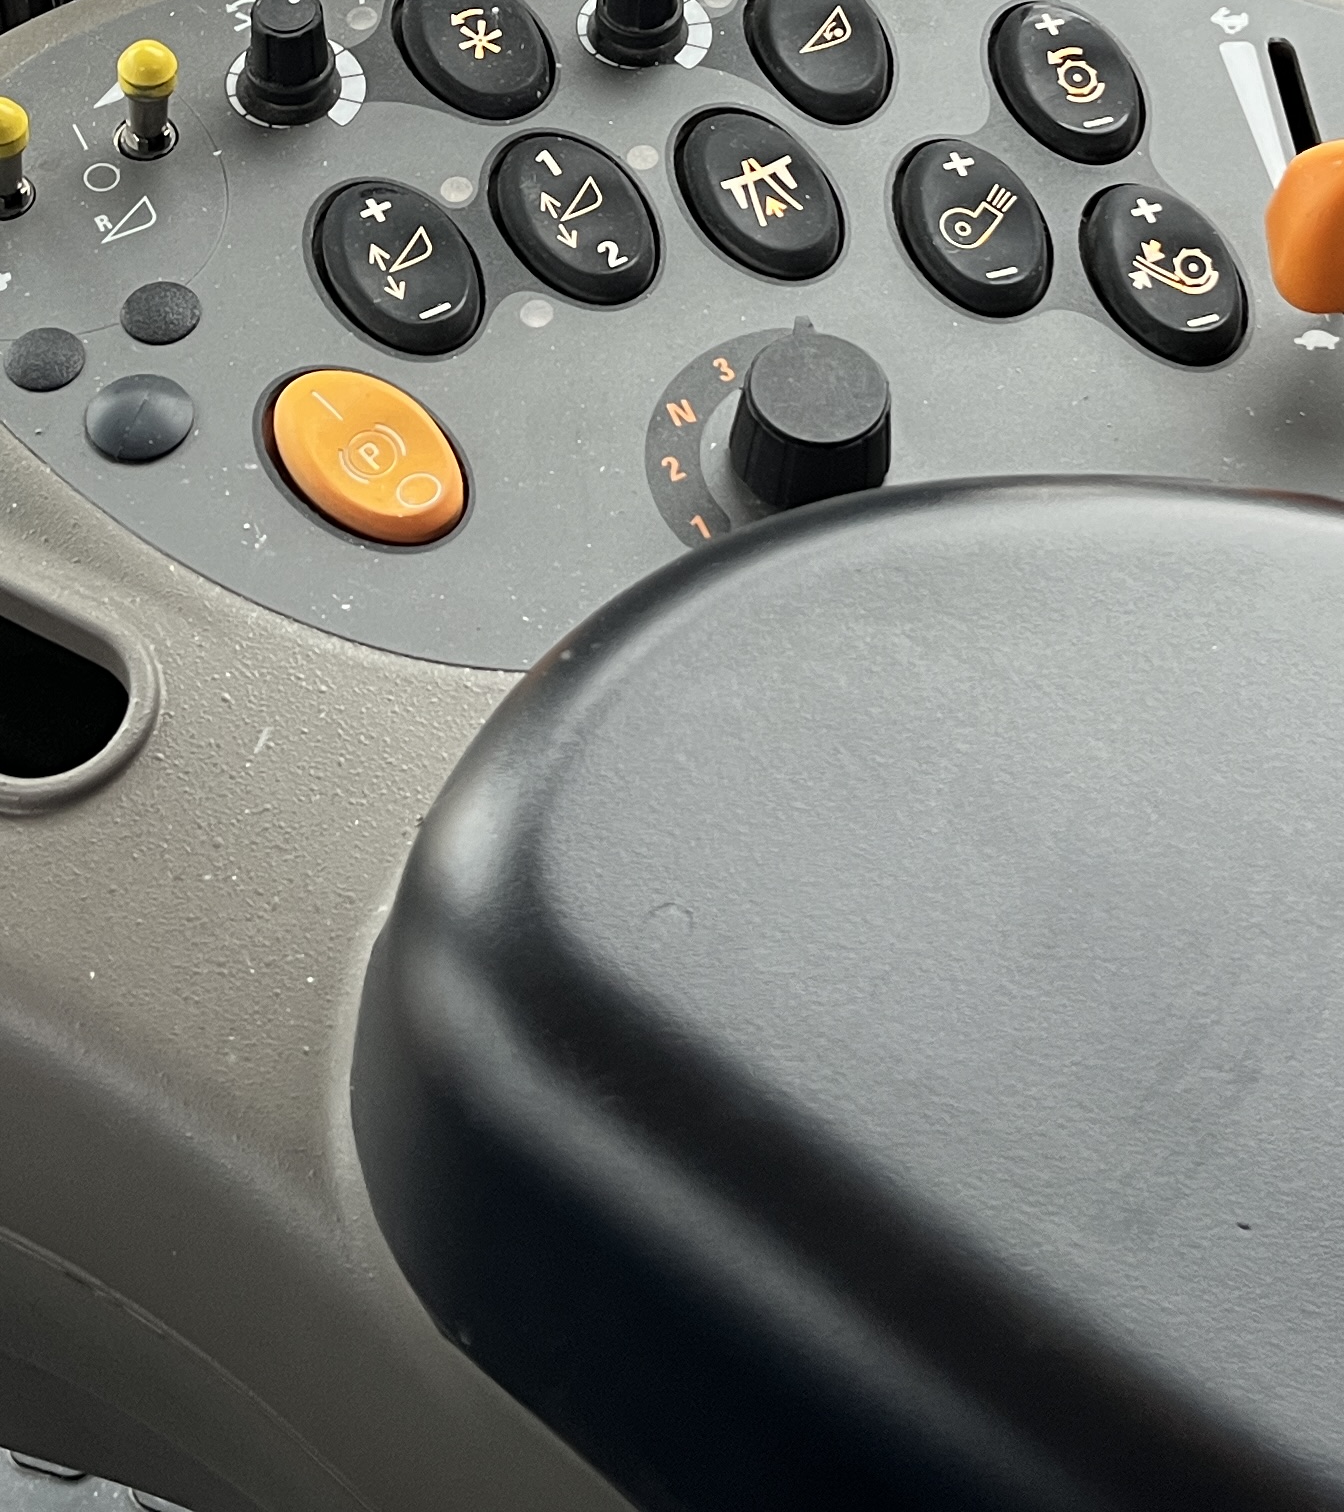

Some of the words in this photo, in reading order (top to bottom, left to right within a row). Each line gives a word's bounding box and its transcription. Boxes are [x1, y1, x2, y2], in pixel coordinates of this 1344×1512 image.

[535, 149, 563, 176] 1
[94, 215, 113, 232] R
[597, 240, 628, 268] 2
[713, 357, 735, 382] 3
[666, 399, 697, 427] N
[359, 442, 380, 470] P
[661, 456, 687, 482] 2
[690, 515, 711, 539] 1
